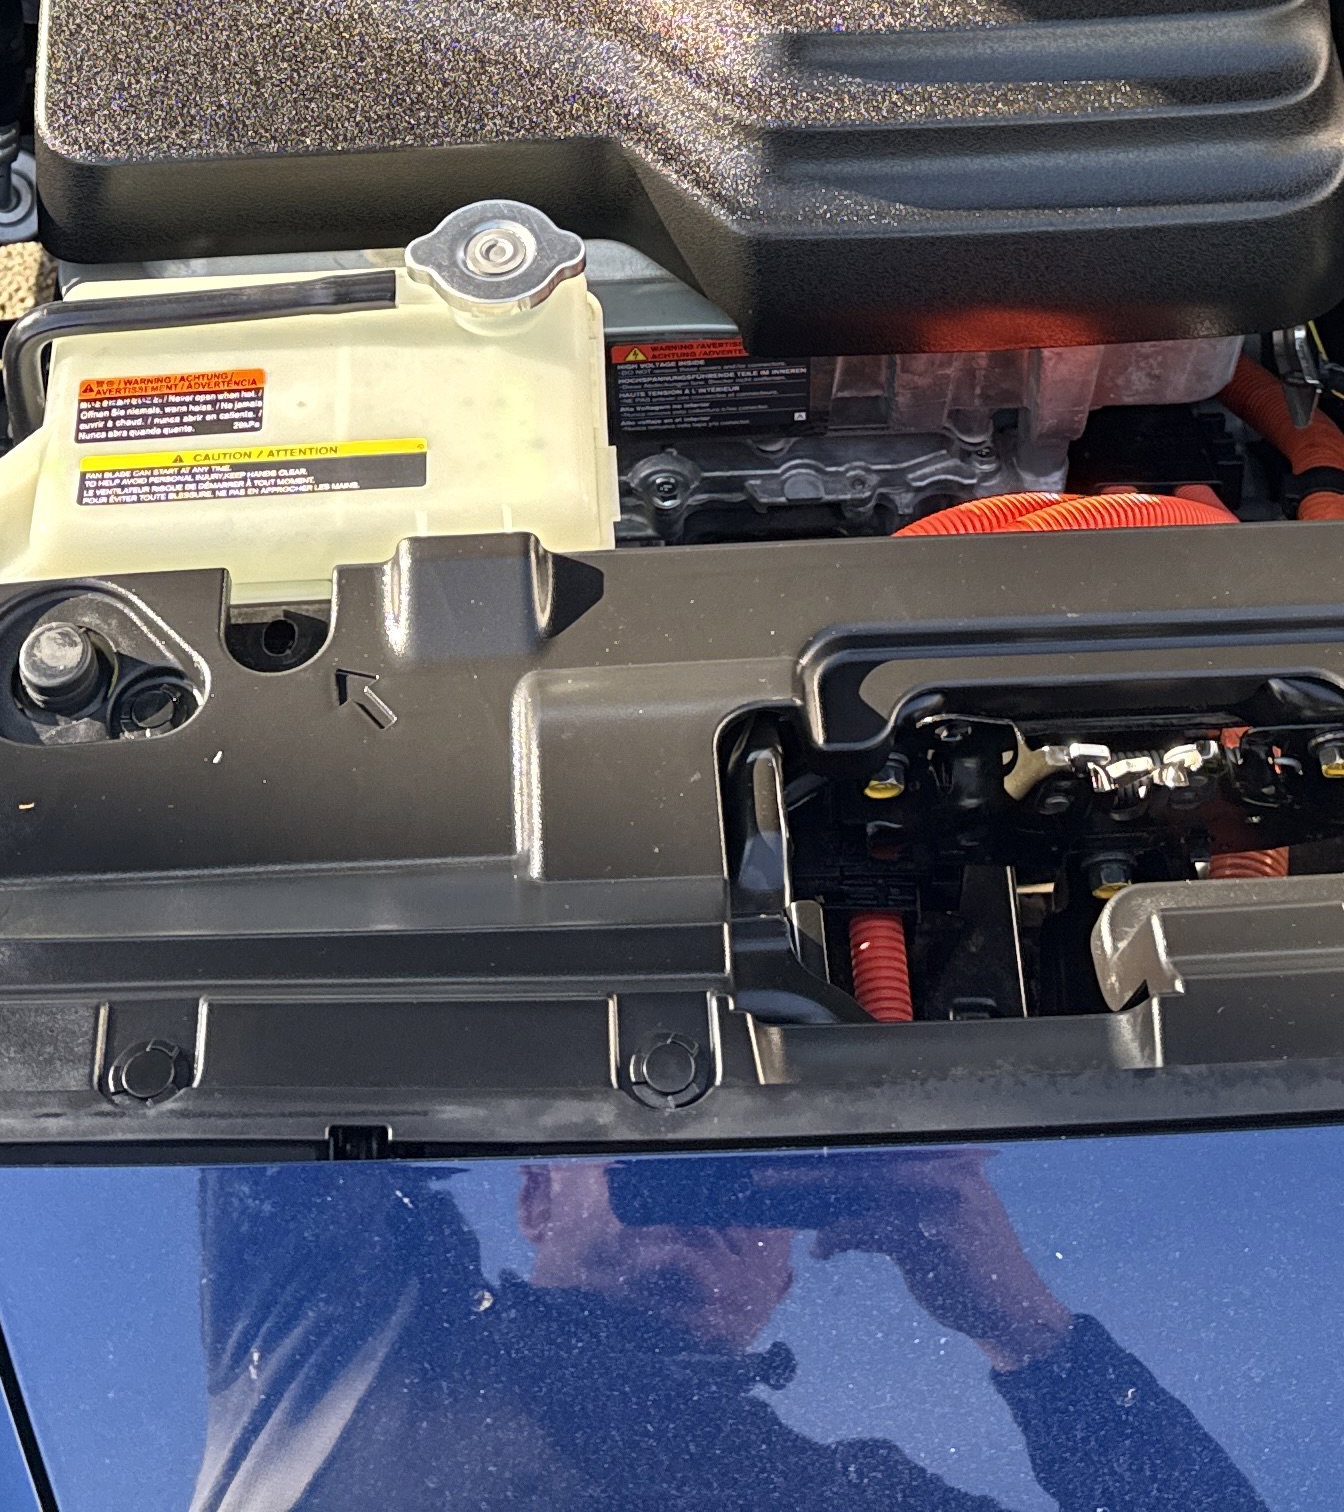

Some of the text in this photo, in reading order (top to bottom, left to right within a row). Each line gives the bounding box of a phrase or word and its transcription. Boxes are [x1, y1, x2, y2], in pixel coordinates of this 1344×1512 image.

[651, 351, 696, 359] ACHTUNG
[123, 376, 171, 386] WARNING
[179, 372, 228, 382] ACHTUNG
[95, 383, 178, 395] AVERTISSEMENT
[193, 450, 251, 461] CAUTION
[267, 446, 337, 457] ATTENTION
[98, 478, 120, 486] HELP
[149, 474, 193, 483] PERSONAL
[247, 470, 276, 478] HANDS
[253, 479, 275, 487] TOUT
